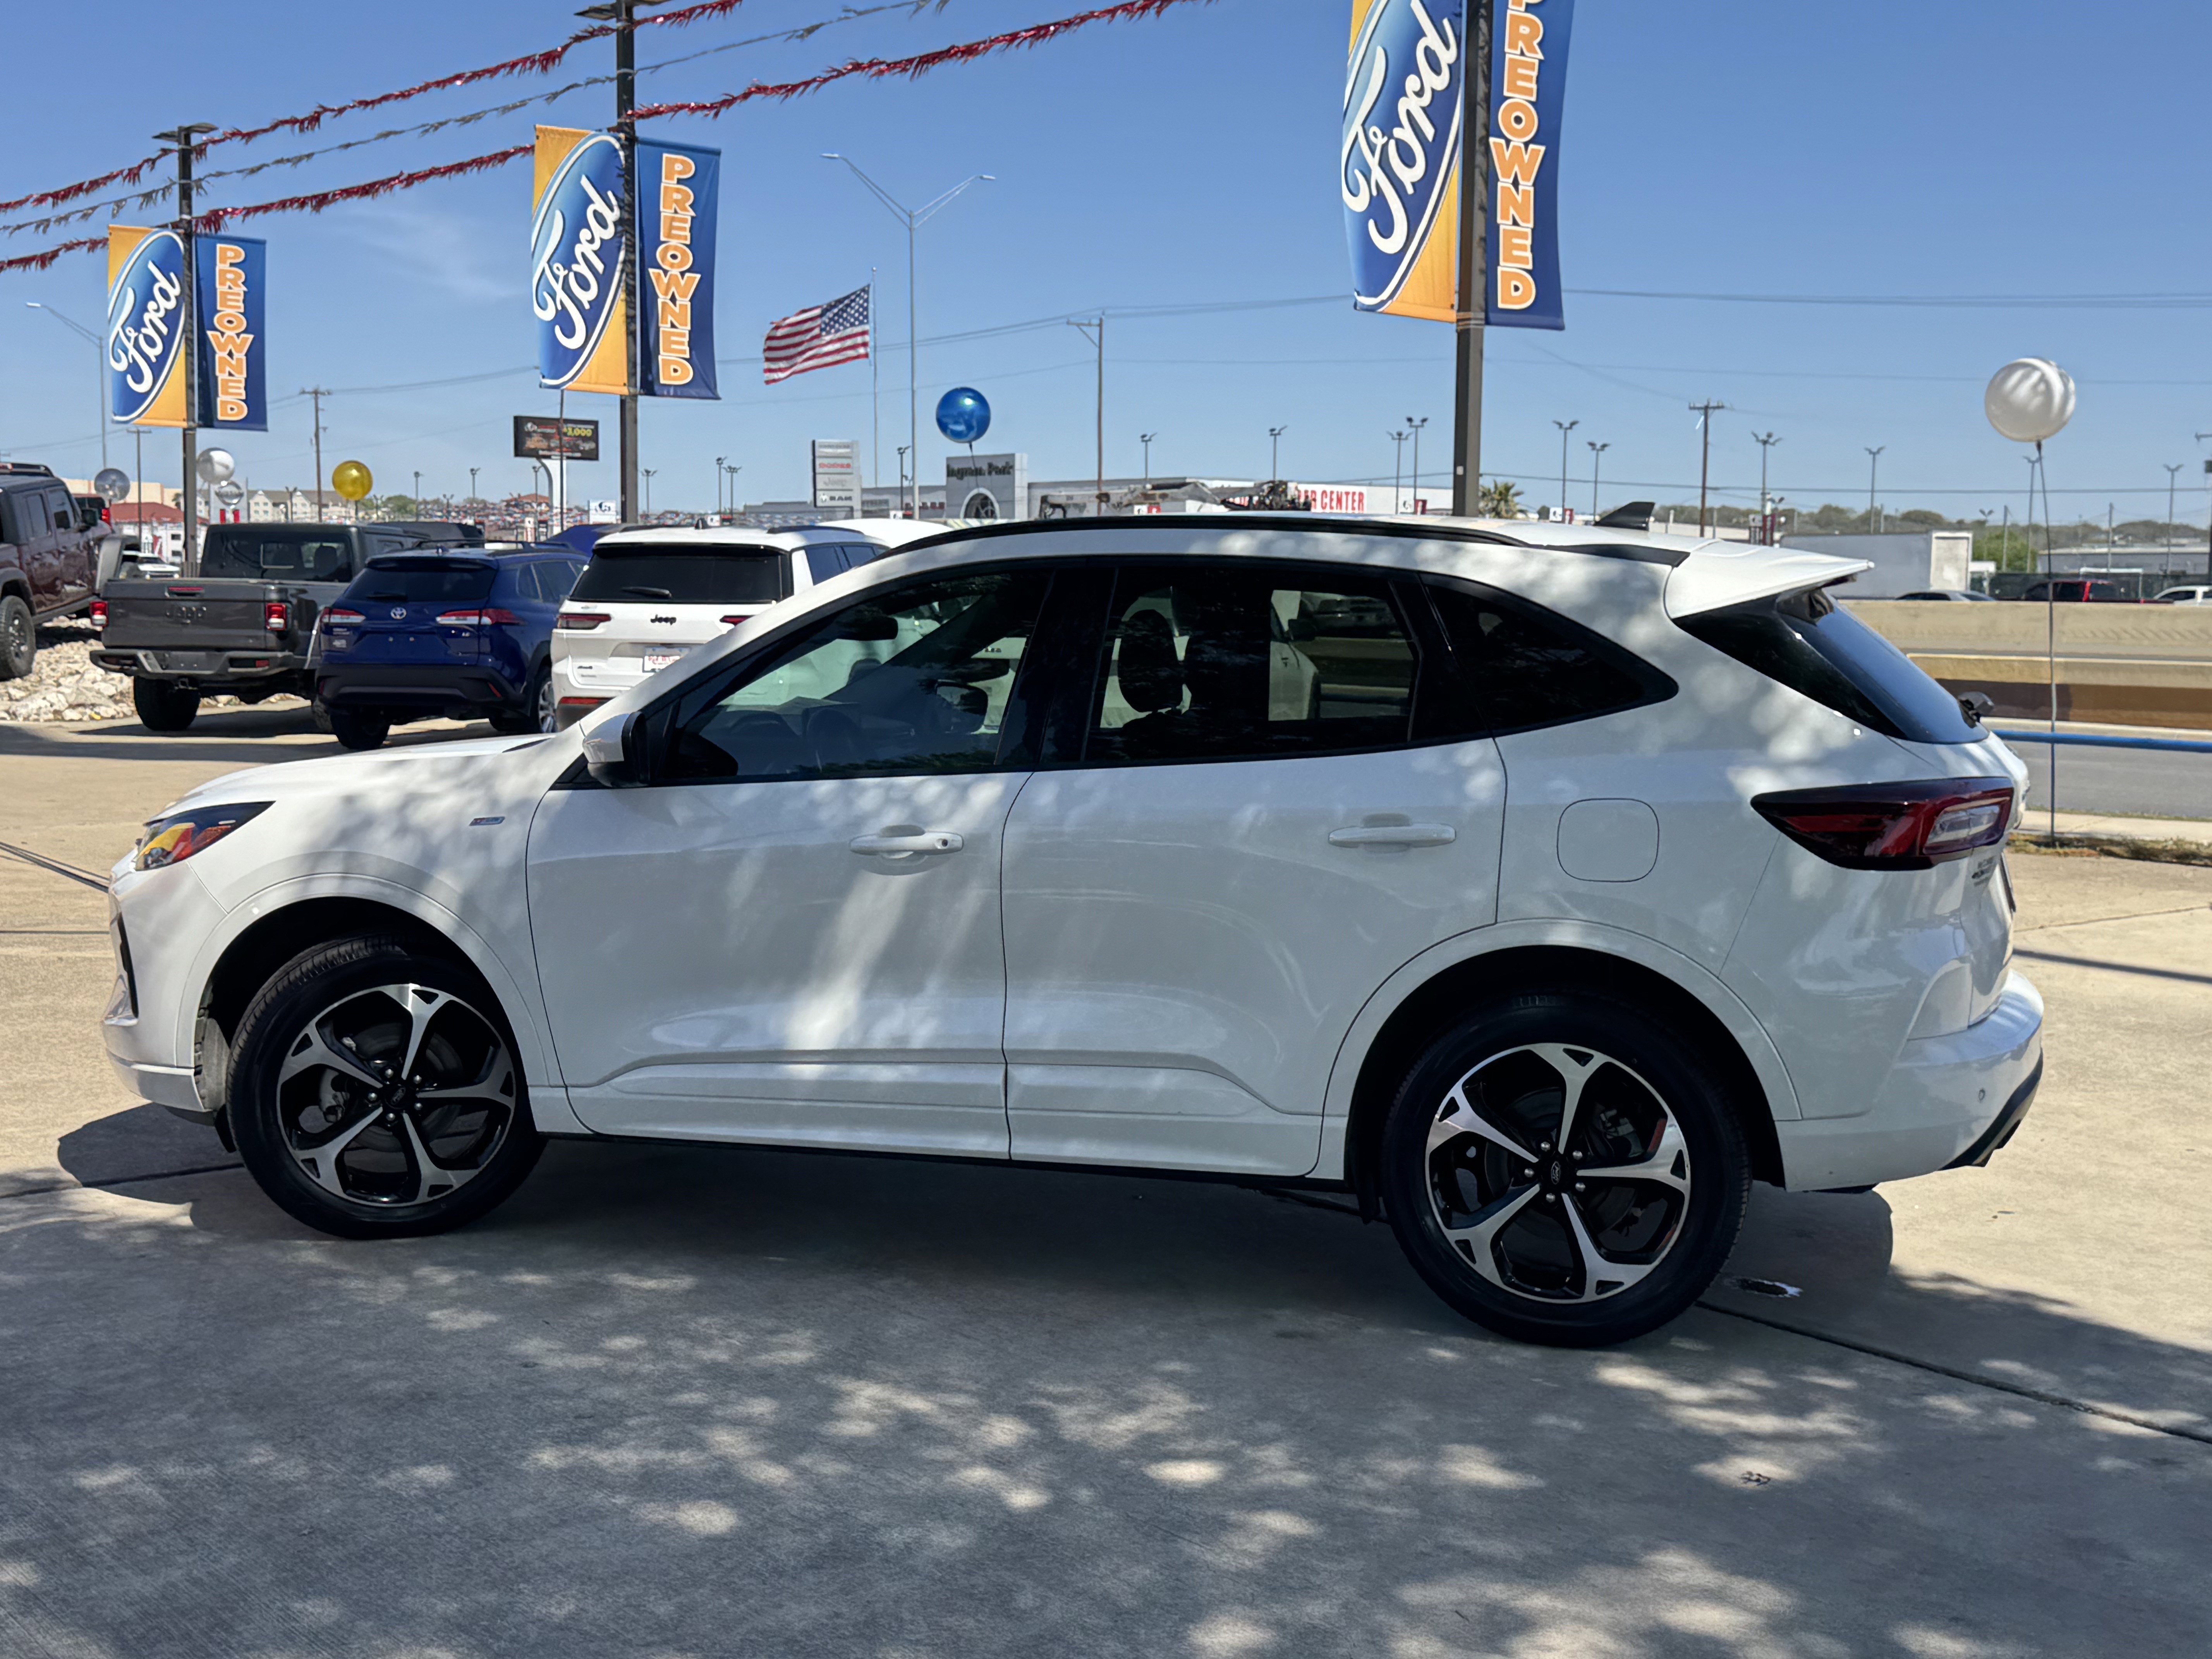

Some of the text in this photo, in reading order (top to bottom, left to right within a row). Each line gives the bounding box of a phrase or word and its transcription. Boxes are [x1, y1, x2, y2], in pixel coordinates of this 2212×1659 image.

[1341, 0, 1458, 254] Ford
[1489, 0, 1546, 309] REOWNED
[109, 260, 182, 393] Ford
[206, 243, 255, 421] PREOWNED
[532, 174, 620, 349] Ford
[649, 153, 701, 385] PREOWNED
[1321, 490, 1365, 512] CENTER
[650, 614, 677, 625] Jeep
